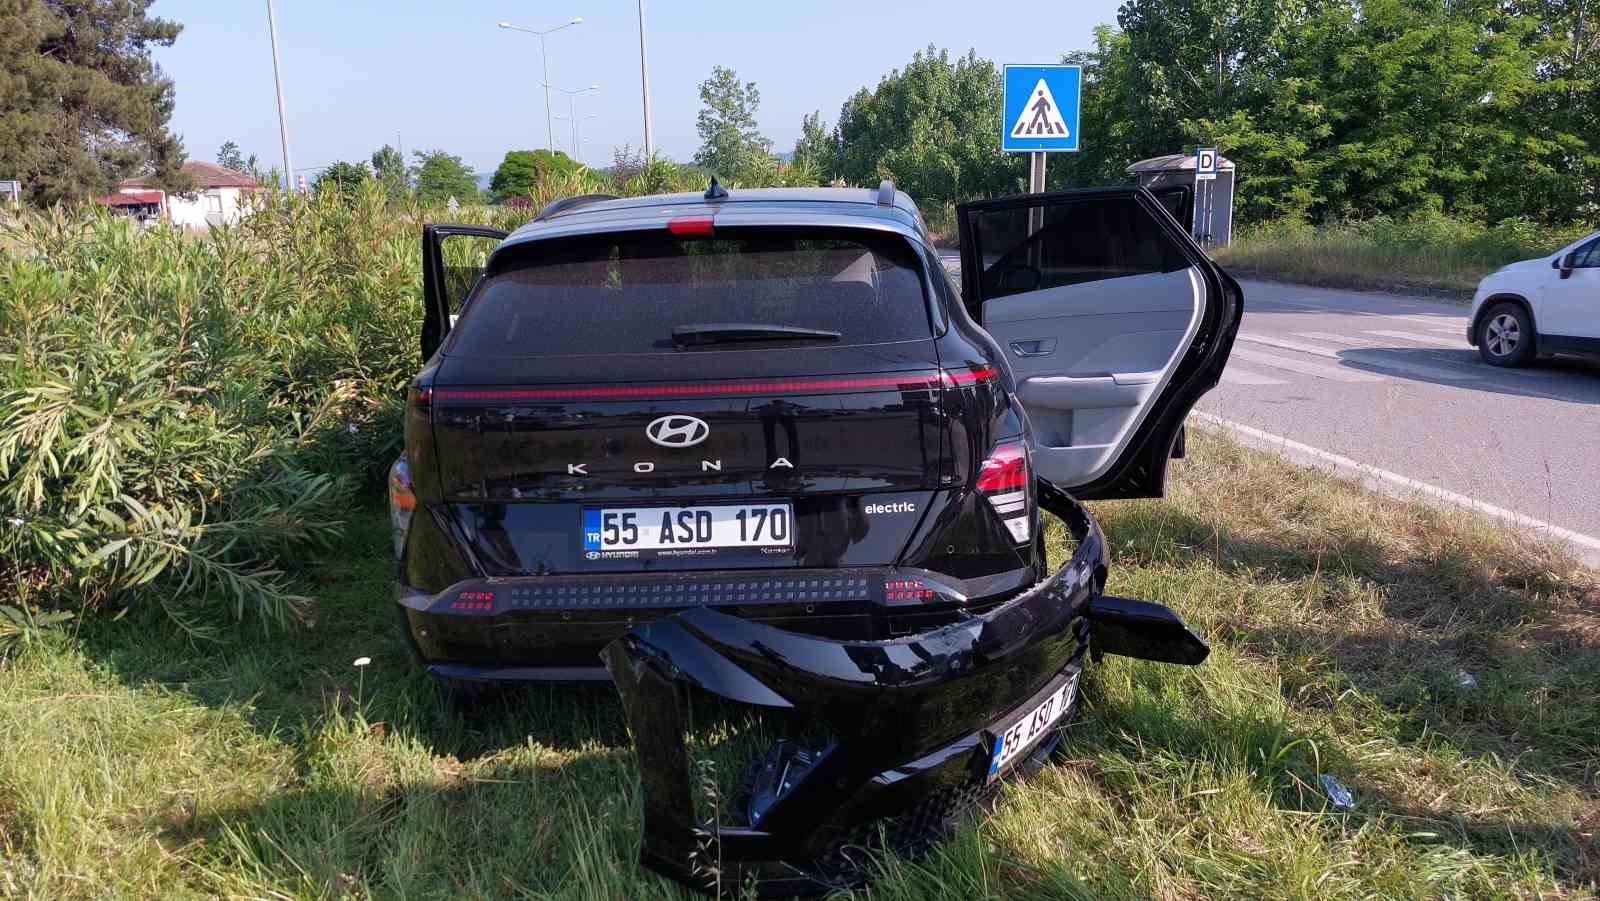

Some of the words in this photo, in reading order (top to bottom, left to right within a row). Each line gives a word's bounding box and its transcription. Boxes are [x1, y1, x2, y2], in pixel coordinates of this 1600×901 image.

[1201, 154, 1212, 168] D
[567, 457, 794, 475] KONA
[865, 501, 915, 514] electric
[587, 533, 600, 543] TR
[603, 513, 638, 545] 55
[659, 510, 712, 543] ASD
[736, 508, 786, 542] 170
[1002, 723, 1023, 761] 55
[1026, 697, 1055, 742] ASD
